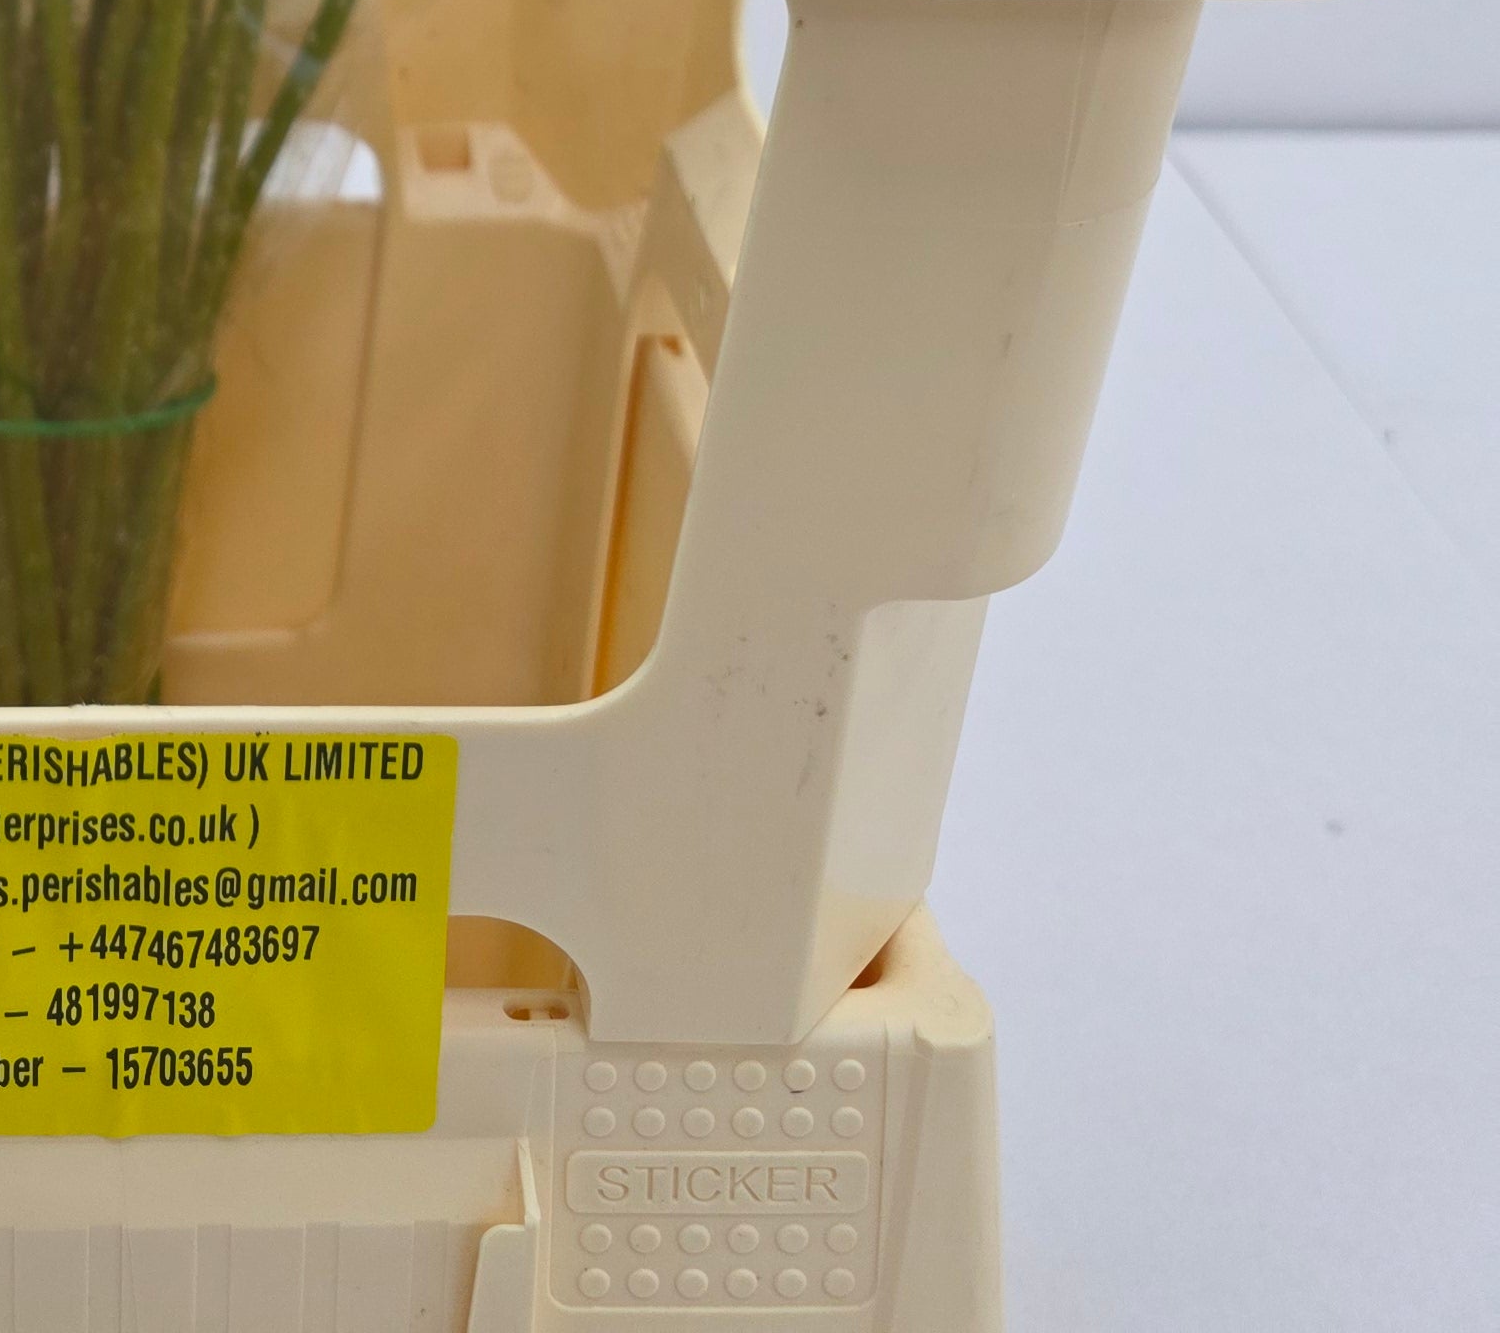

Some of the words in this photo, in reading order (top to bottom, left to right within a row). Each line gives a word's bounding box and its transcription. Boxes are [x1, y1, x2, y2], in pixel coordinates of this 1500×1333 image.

[224, 741, 270, 782] UK
[284, 741, 424, 781] LIMITED
[58, 924, 320, 969] +447467483697
[46, 981, 216, 1029] 481997138
[105, 1045, 253, 1090] 15703655
[596, 1164, 840, 1203] STICKER
